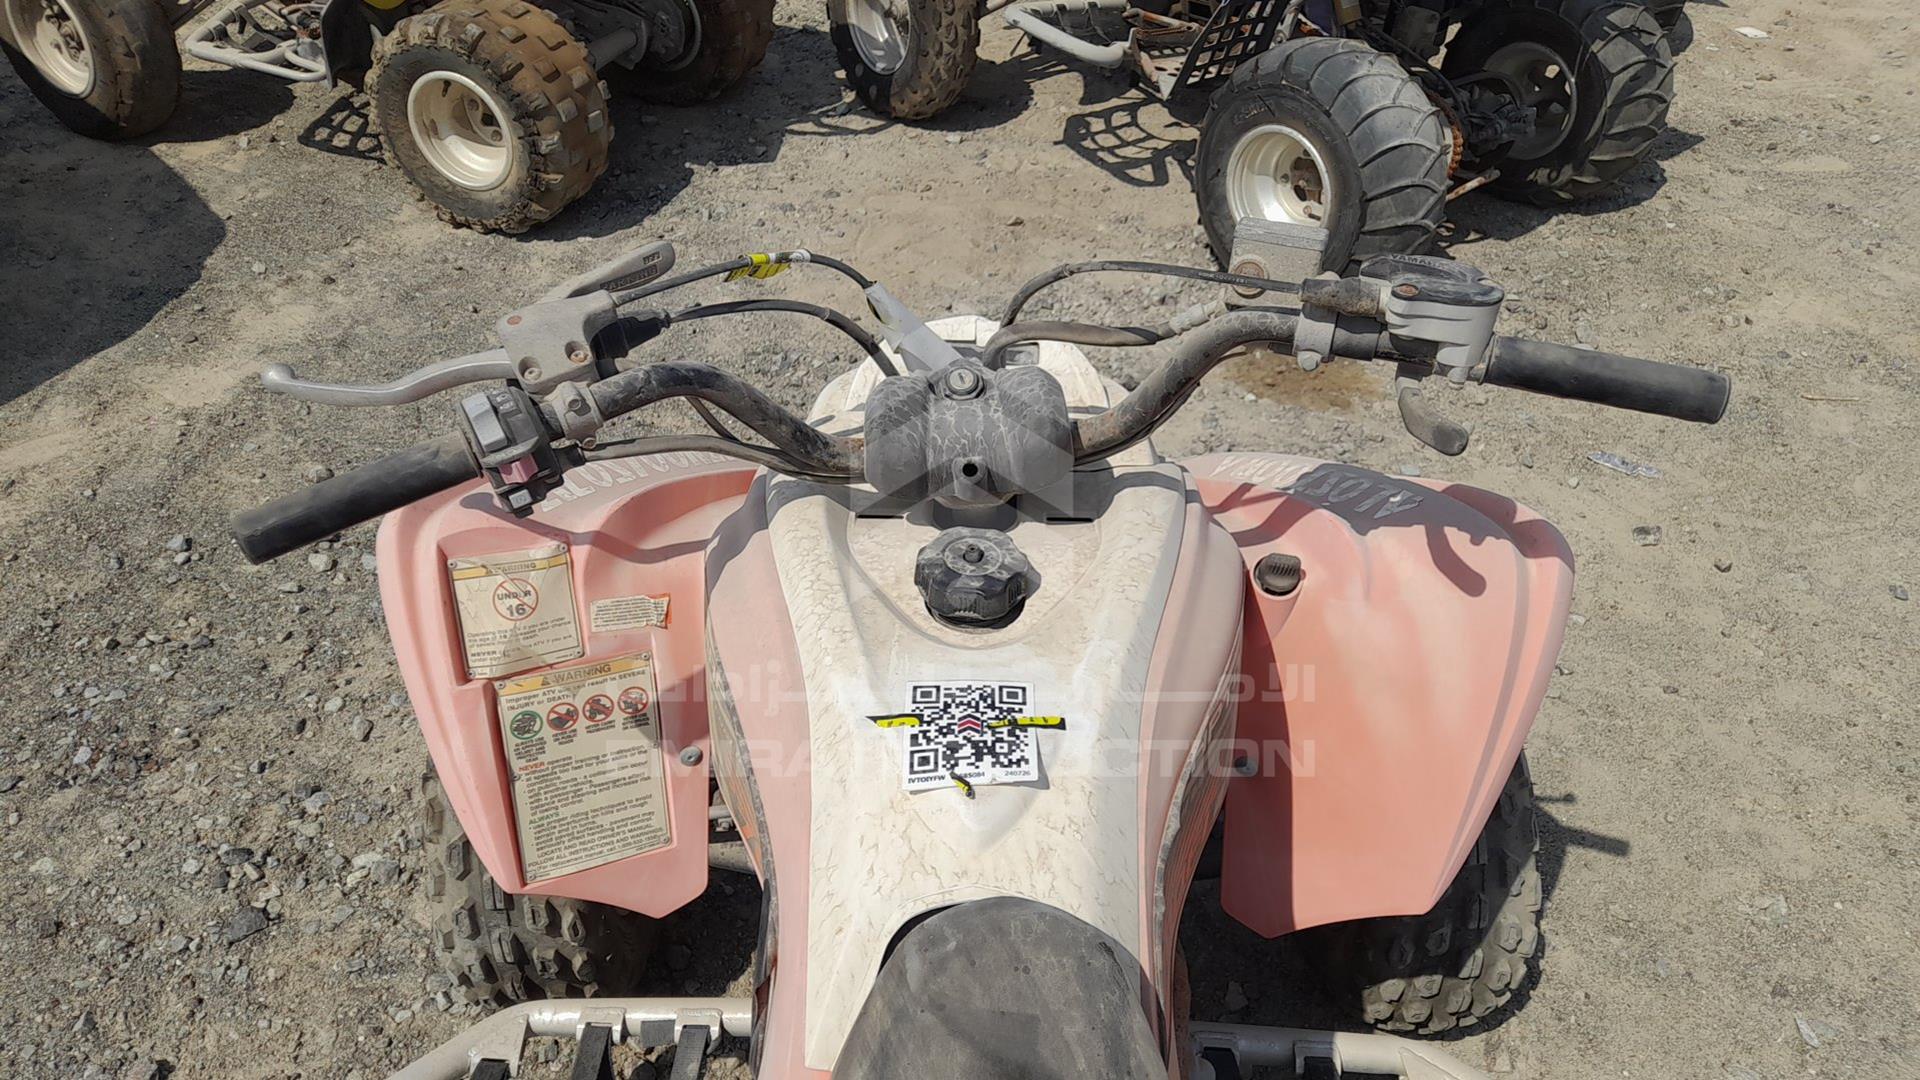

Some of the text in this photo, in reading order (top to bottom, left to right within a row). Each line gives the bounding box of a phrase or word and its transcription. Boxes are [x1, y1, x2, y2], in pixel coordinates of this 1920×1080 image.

[506, 602, 526, 617] 16
[471, 649, 497, 658] NEVER
[554, 663, 612, 683] WARNING
[506, 693, 540, 705] Improper
[542, 689, 557, 697] ATV
[587, 677, 609, 686] result
[617, 669, 646, 680] SEVERE
[507, 701, 535, 712] INJURY
[518, 761, 545, 772] NEVER
[528, 811, 560, 825] ALWAYS
